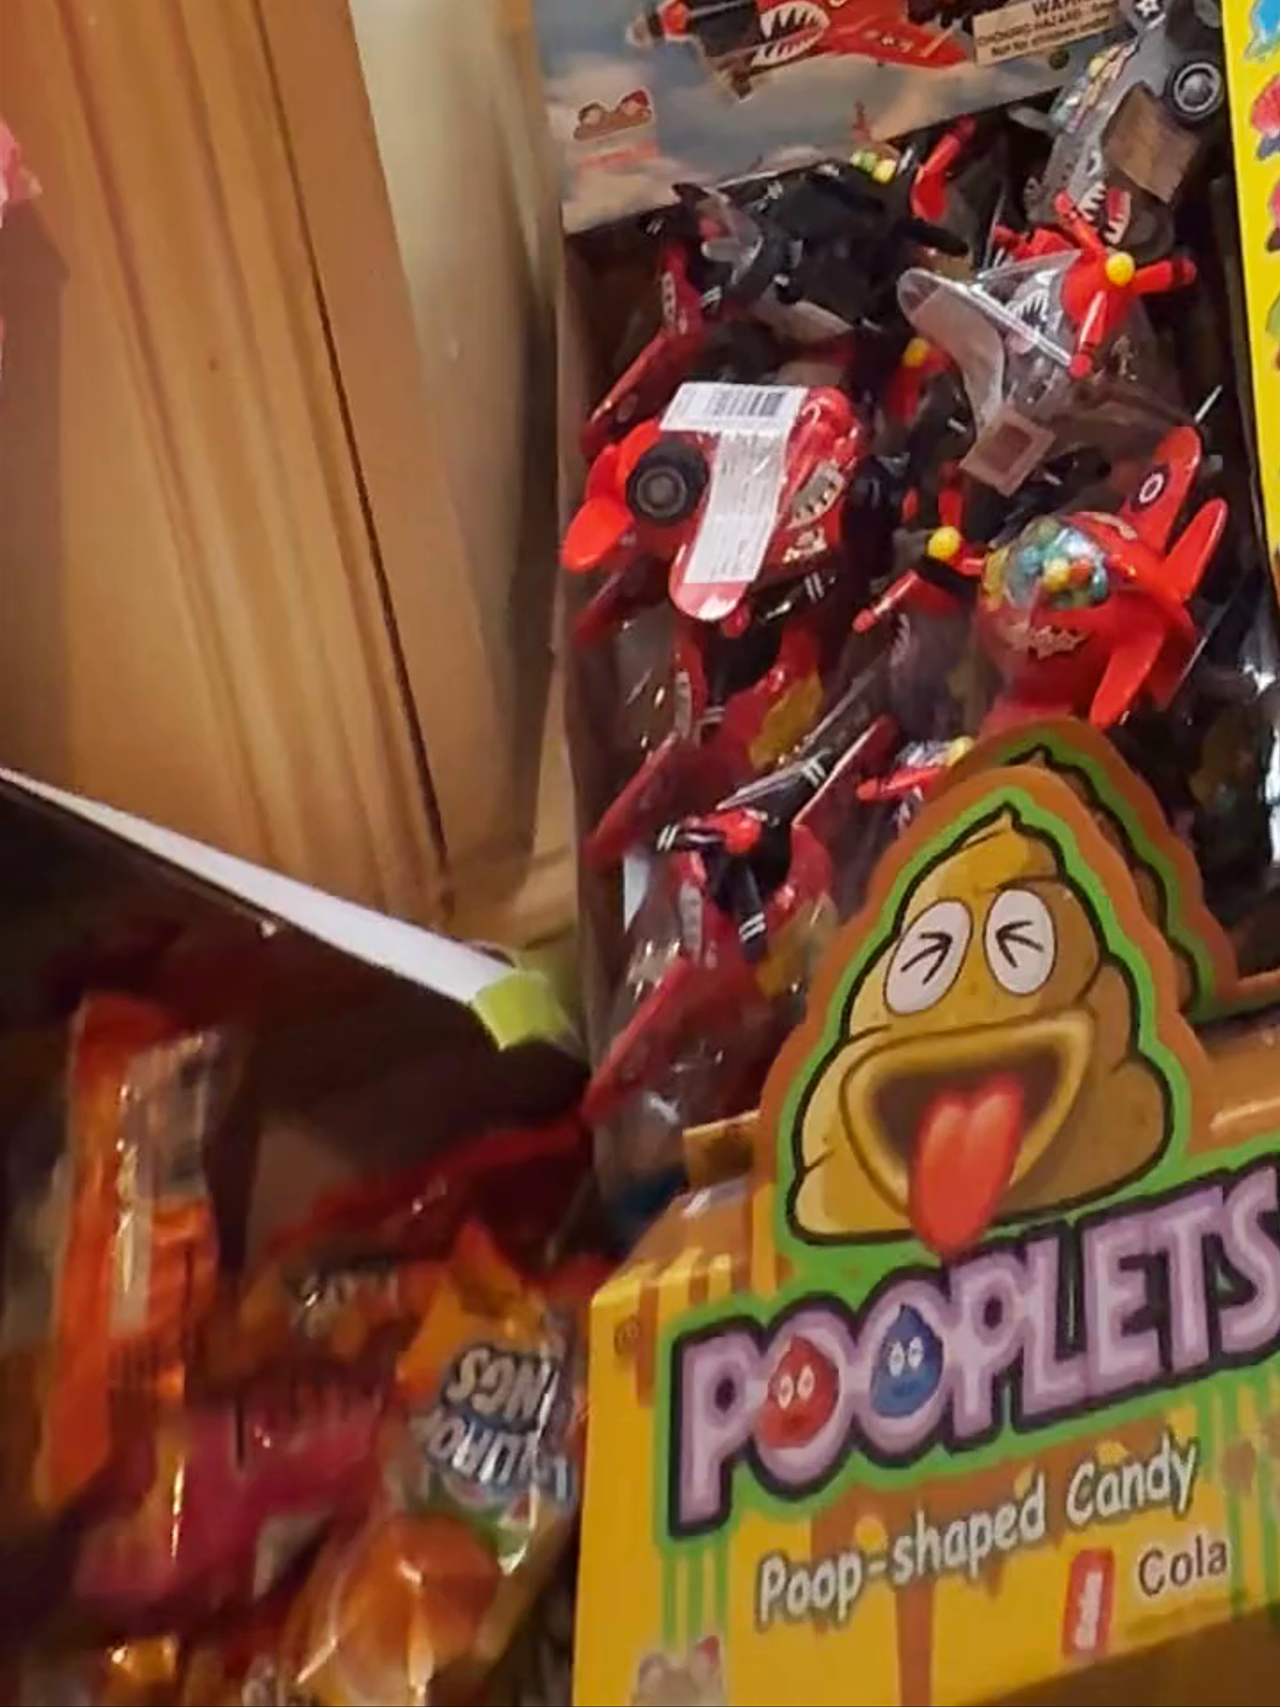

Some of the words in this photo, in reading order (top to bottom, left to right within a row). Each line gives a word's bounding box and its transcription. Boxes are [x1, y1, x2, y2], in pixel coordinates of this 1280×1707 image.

[756, 1476, 1047, 1628] Poop-shaped
[1065, 1426, 1199, 1533] Candy
[1137, 1535, 1230, 1597] Cola
